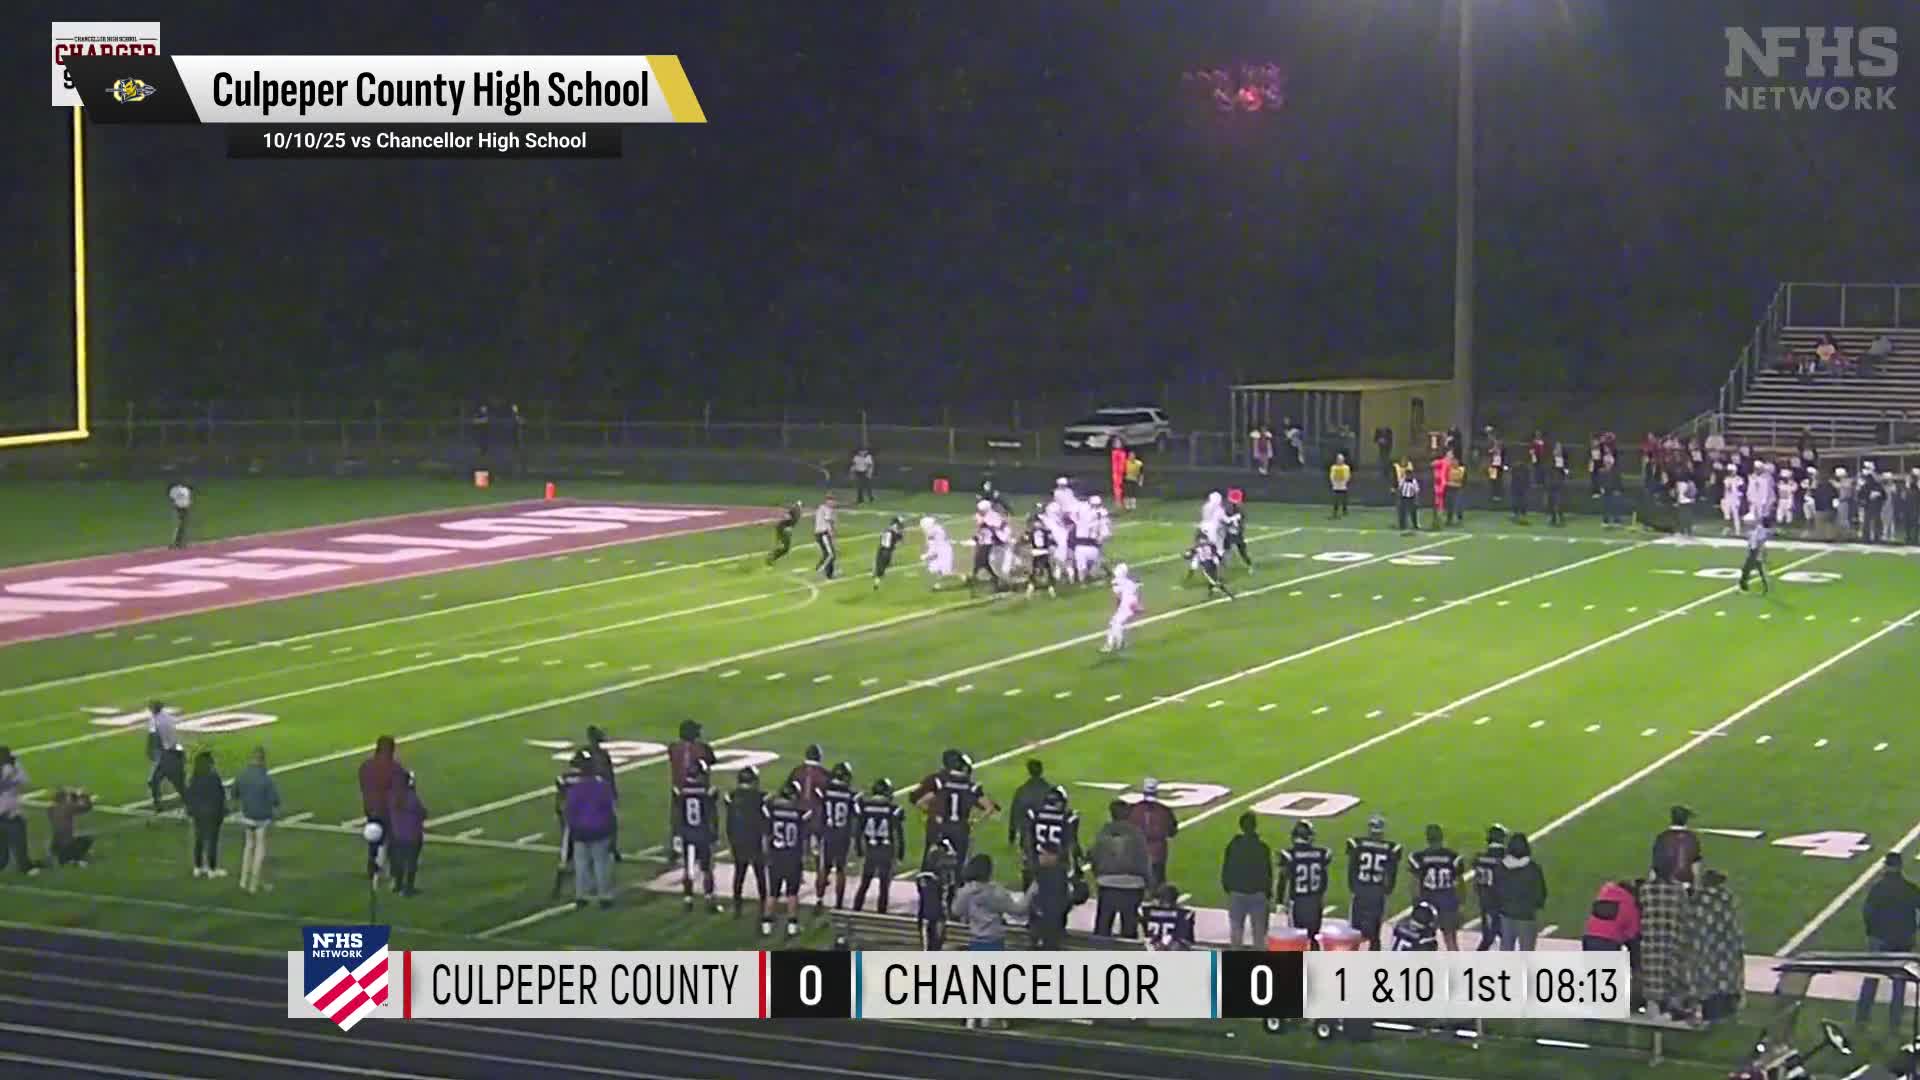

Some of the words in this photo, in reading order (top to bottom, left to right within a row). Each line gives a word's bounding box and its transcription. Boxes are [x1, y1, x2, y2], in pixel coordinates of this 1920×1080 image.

[686, 797, 700, 826] 8
[949, 792, 960, 822] 1
[772, 820, 798, 849] 50
[864, 817, 892, 846] 44
[1357, 852, 1388, 883] 25
